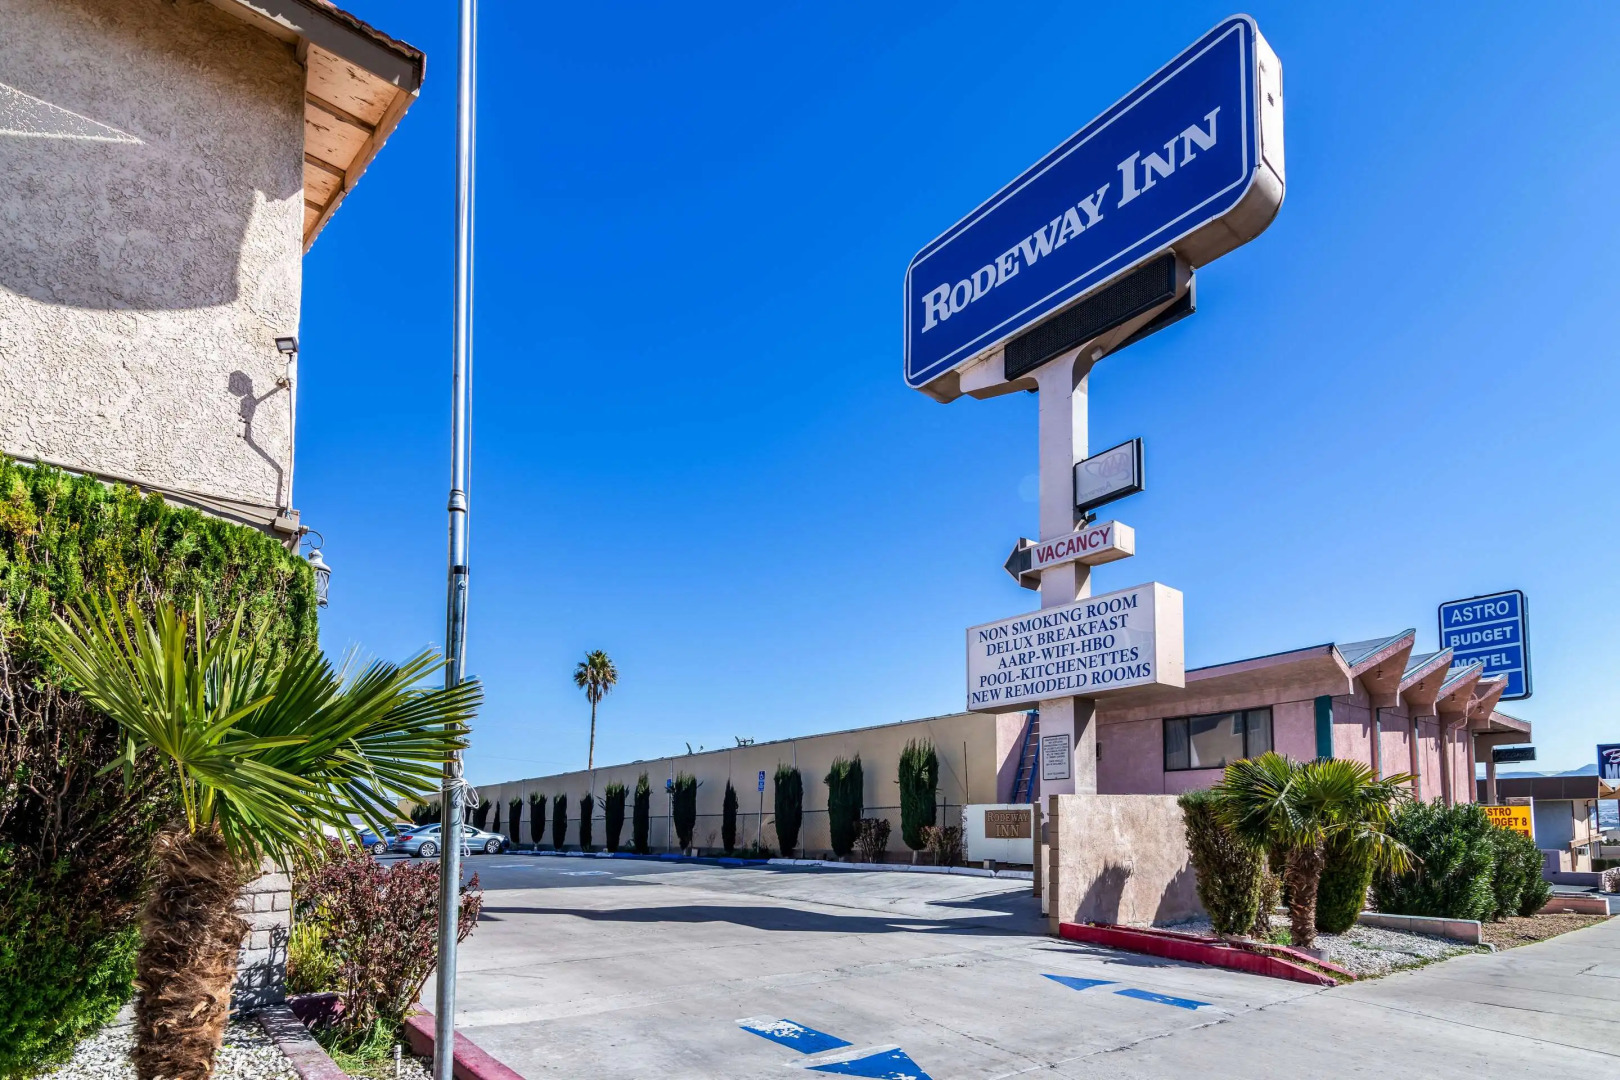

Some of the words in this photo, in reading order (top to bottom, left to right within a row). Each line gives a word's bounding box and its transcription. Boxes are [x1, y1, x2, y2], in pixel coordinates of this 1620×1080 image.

[922, 183, 1109, 334] RODEWAY
[1117, 106, 1221, 208] INN
[1036, 527, 1111, 563] VACANCY
[979, 625, 1009, 643] NON
[1012, 607, 1082, 636] SMOKING
[1086, 594, 1138, 618] ROOM
[1451, 600, 1509, 624] ASTRO
[986, 635, 1033, 656] DELUX
[1037, 613, 1128, 646] BREAKFAST
[998, 634, 1115, 669] AARP-WIFI-HBO
[1450, 626, 1513, 647] BUDGET
[972, 688, 1002, 704] NEW
[1005, 673, 1088, 699] REMODELD
[1091, 662, 1151, 685] ROOMS
[979, 646, 1139, 688] POOL-KITCHENETTES
[987, 812, 1029, 822] RODEWAY
[996, 824, 1020, 837] INN
[1488, 817, 1519, 827] UDGET
[1521, 817, 1528, 826] 8
